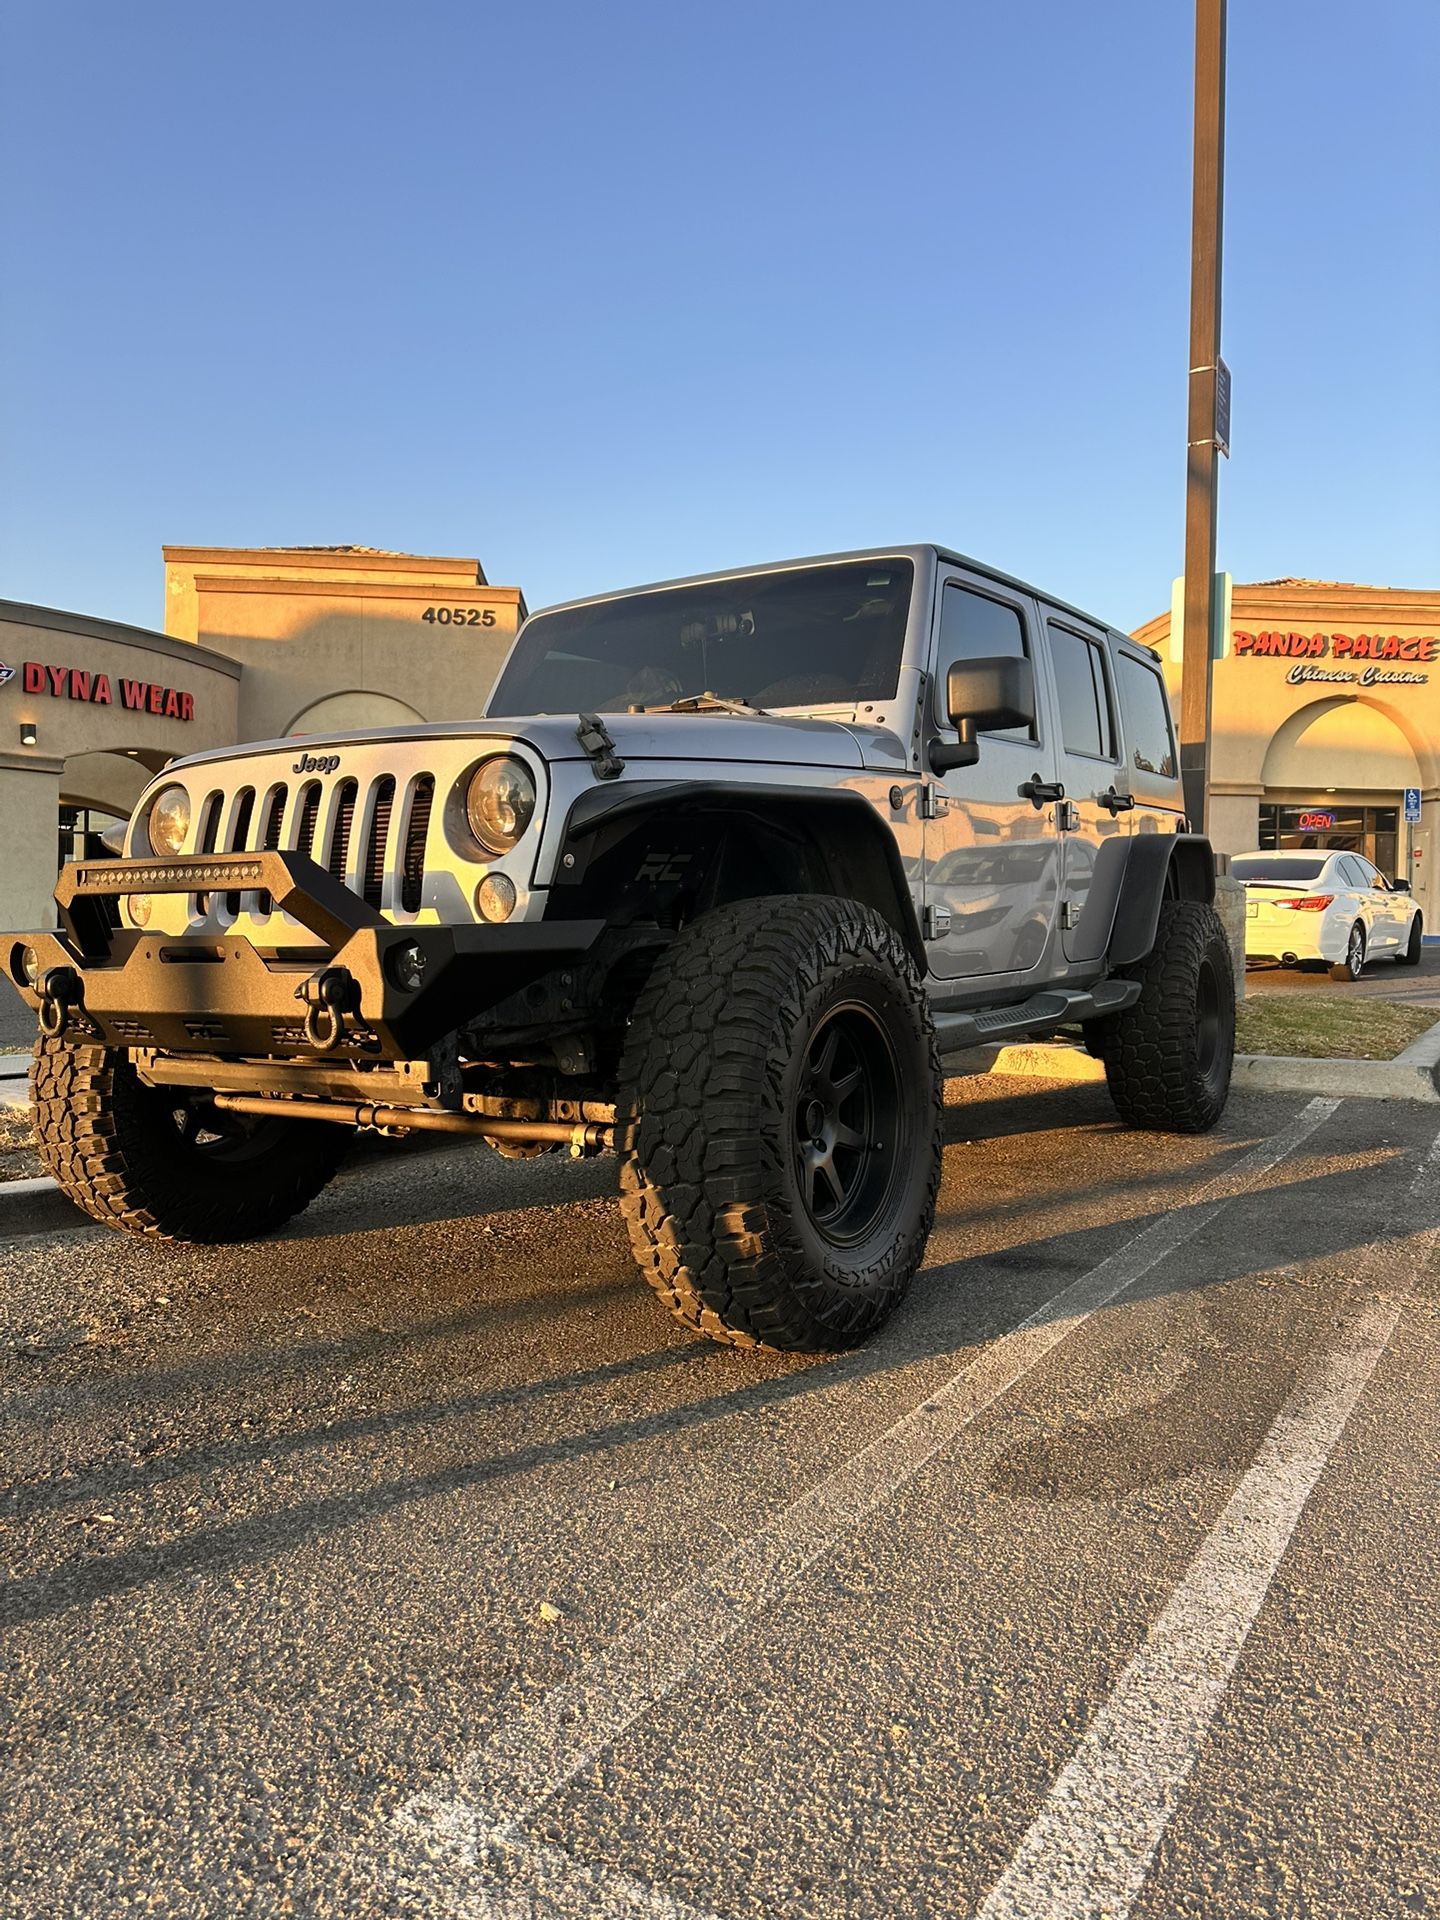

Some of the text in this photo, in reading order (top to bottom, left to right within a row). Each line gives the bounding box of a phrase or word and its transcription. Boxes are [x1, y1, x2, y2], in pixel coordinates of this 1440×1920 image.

[422, 606, 497, 627] 40525
[1233, 630, 1440, 662] PANDA PALACE
[1286, 663, 1426, 686] Chinese Cuisine
[23, 661, 195, 721] DYNA WEAR
[292, 753, 341, 775] Jeep
[1299, 812, 1334, 828] OPEN
[634, 853, 694, 881] RC
[823, 1231, 906, 1288] FALKEN
